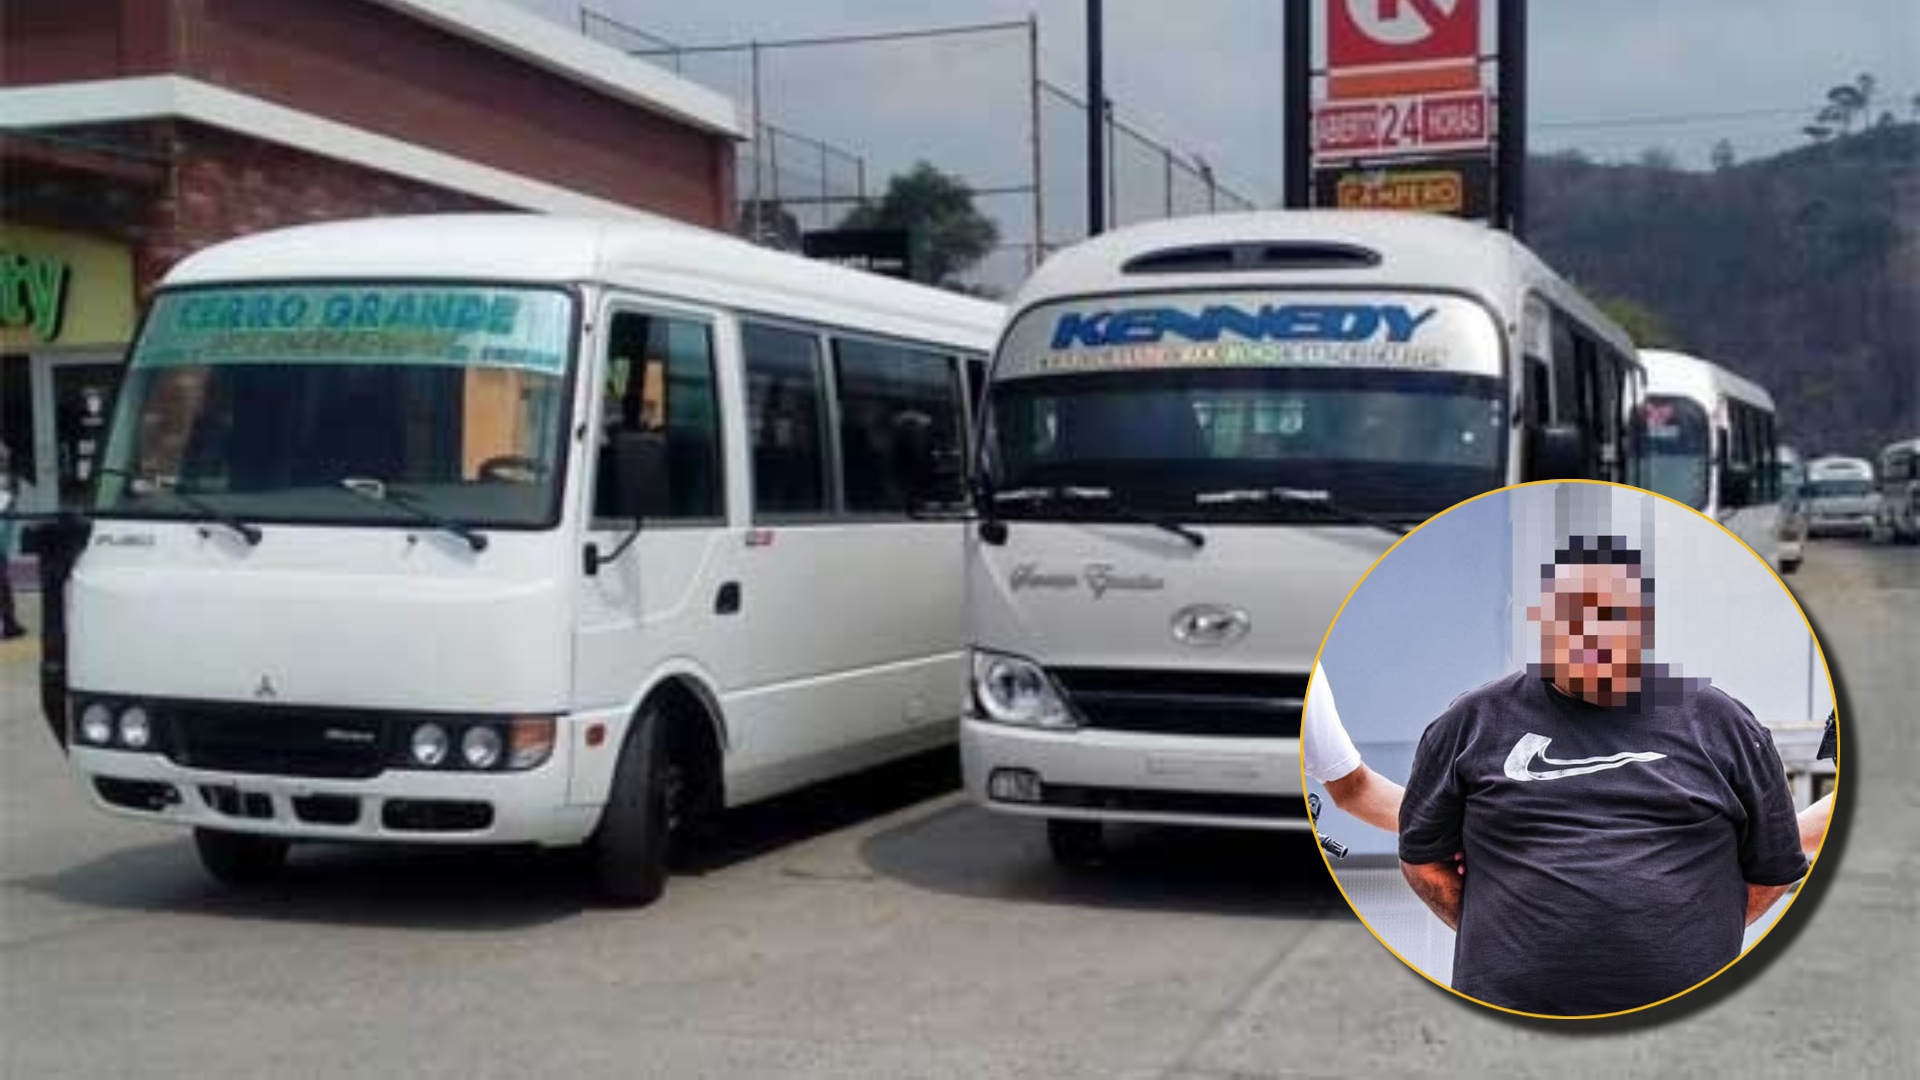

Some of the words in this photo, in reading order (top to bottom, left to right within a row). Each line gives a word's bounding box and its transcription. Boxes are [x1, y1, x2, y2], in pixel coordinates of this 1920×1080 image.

[1381, 103, 1418, 146] 24
[1428, 104, 1480, 140] HORAS
[1340, 177, 1458, 208] CAMPERO
[178, 294, 306, 330] CERRO
[323, 293, 521, 334] GRANDE
[1051, 303, 1438, 349] KENNEDY
